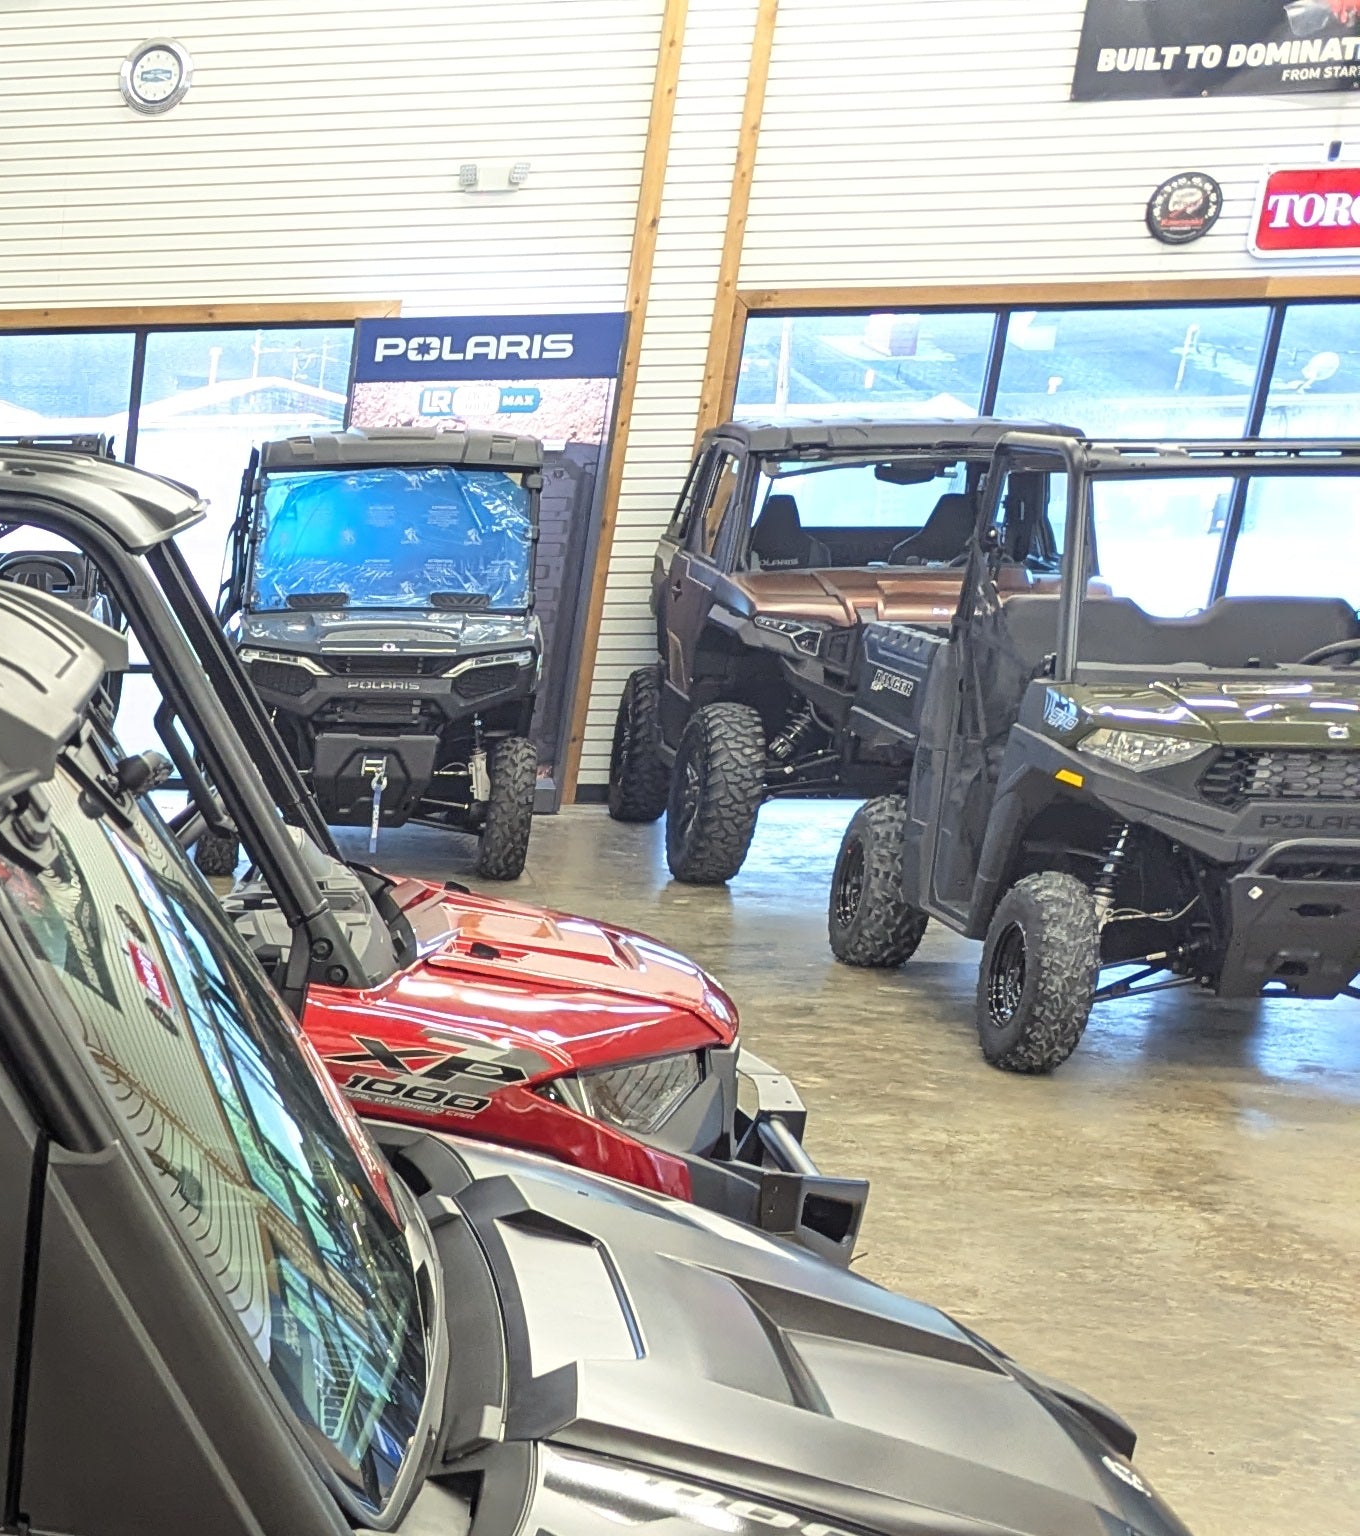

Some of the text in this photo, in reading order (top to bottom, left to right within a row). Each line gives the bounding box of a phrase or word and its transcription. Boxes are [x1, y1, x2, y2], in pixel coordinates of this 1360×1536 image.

[1097, 37, 1360, 72] BUILT TO DOMINAT
[1281, 65, 1360, 81] FROM STAR
[374, 334, 573, 362] POLARIS
[501, 395, 534, 407] MAX
[347, 680, 420, 691] POLARIS
[323, 1034, 529, 1085] XP
[345, 1073, 492, 1113] 1000
[374, 1096, 446, 1115] OVERHEAD
[445, 1109, 476, 1120] CAM
